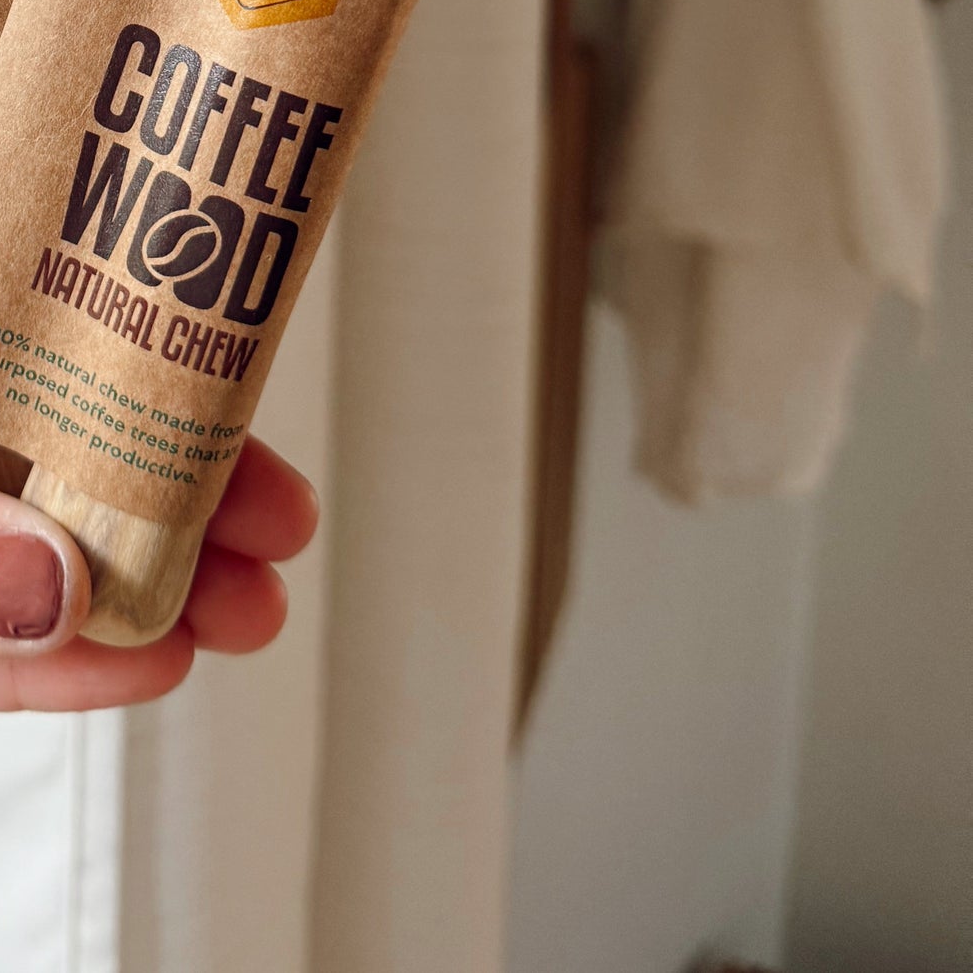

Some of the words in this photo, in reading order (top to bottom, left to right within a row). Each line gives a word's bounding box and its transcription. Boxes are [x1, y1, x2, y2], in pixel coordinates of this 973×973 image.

[93, 23, 344, 213] COFFEE
[60, 130, 299, 326] WOOD
[31, 247, 160, 351] NATURAL
[160, 315, 260, 382] CHEW
[6, 387, 29, 405] no
[34, 396, 87, 437] longer
[89, 434, 197, 484] productive.
[34, 345, 96, 386] natural
[99, 383, 147, 414] chew
[150, 409, 205, 435] made
[71, 394, 125, 433] coffee
[130, 426, 179, 455] trees
[185, 445, 220, 461] that
